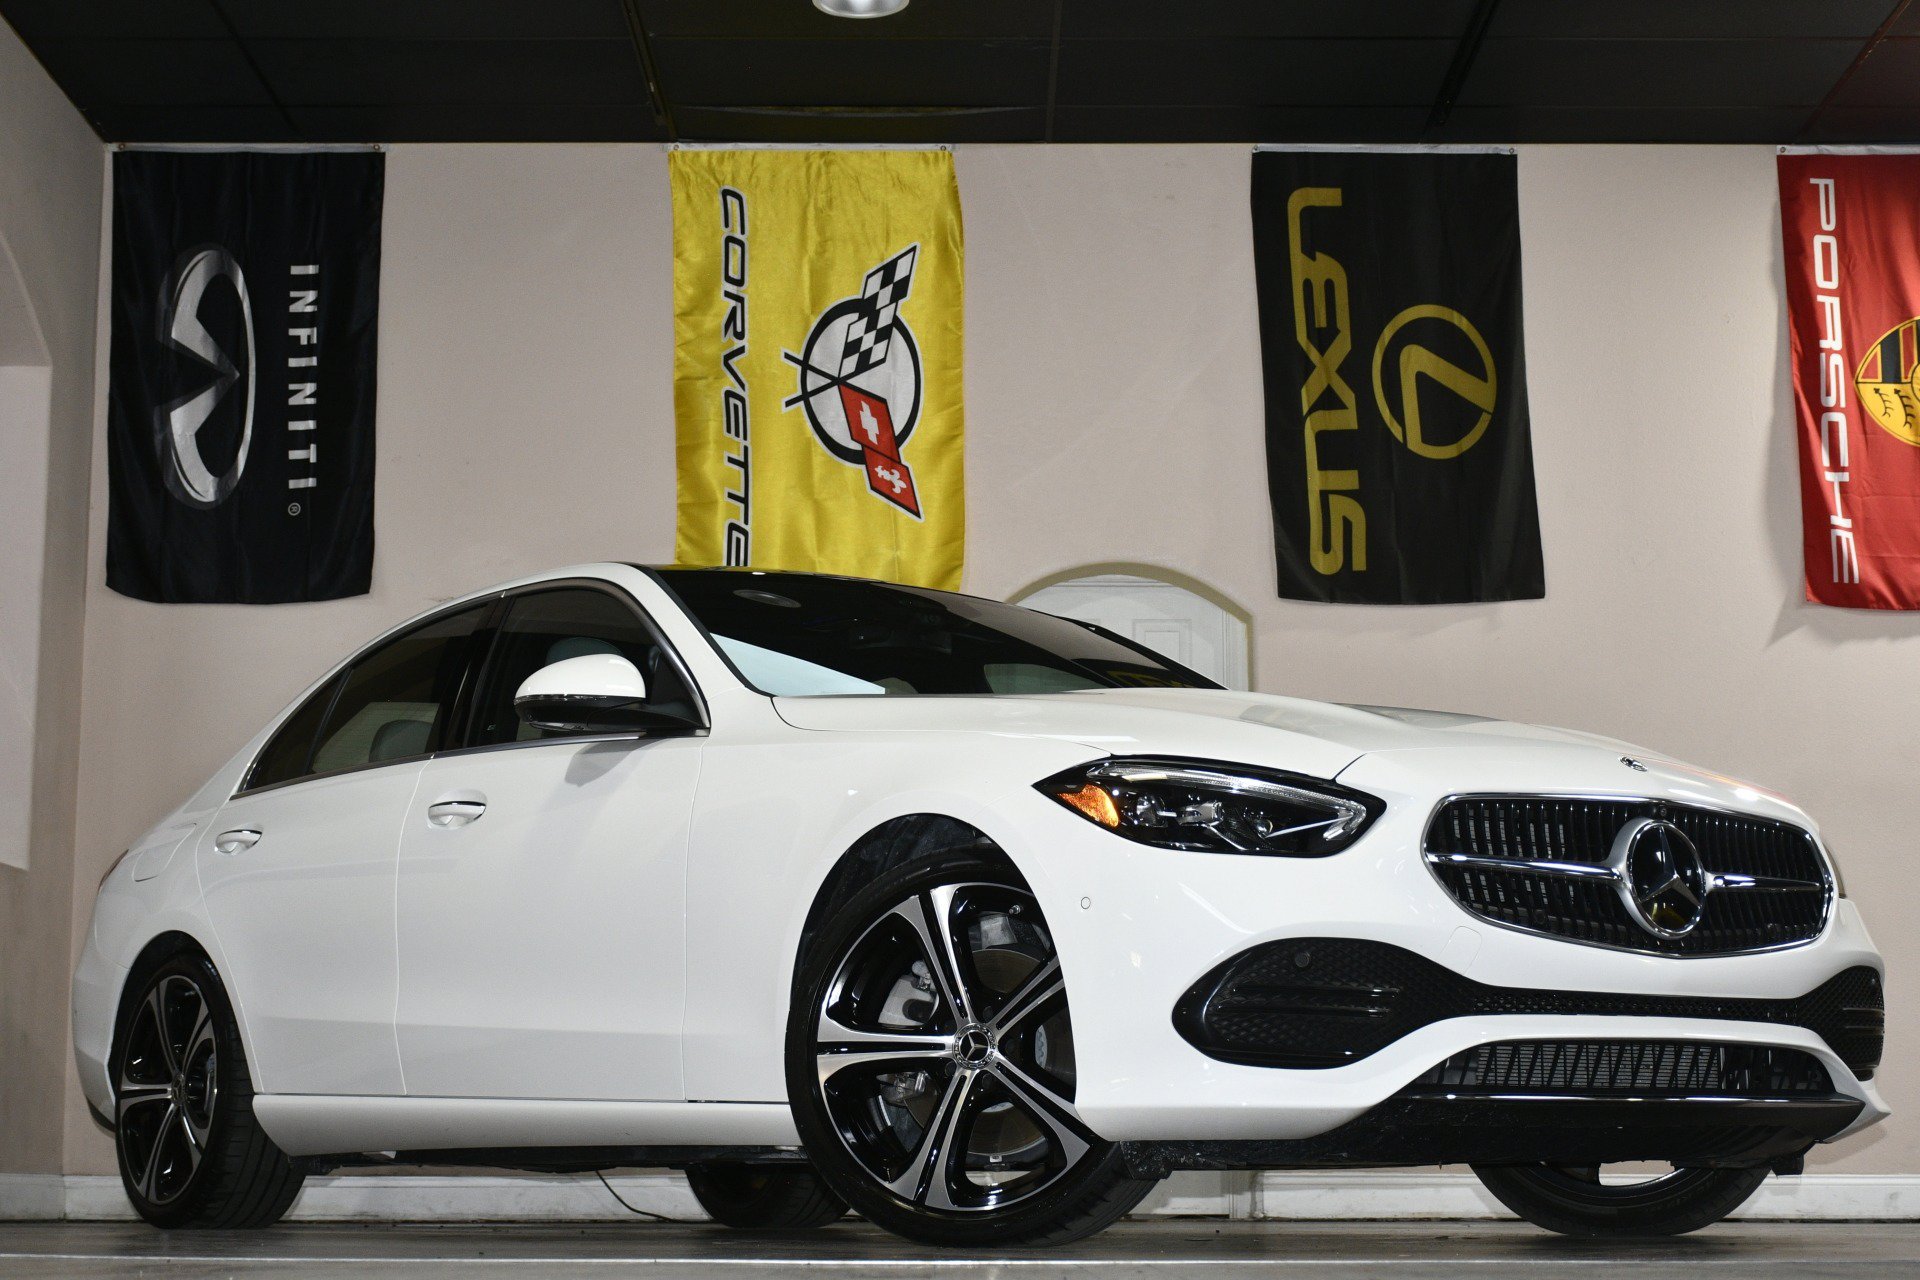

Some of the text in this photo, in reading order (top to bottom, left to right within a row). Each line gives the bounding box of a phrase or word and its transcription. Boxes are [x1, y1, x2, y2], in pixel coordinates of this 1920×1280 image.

[719, 186, 750, 566] CORVETTE
[1287, 187, 1366, 575] LEXUS
[1810, 177, 1859, 584] PORSCHE
